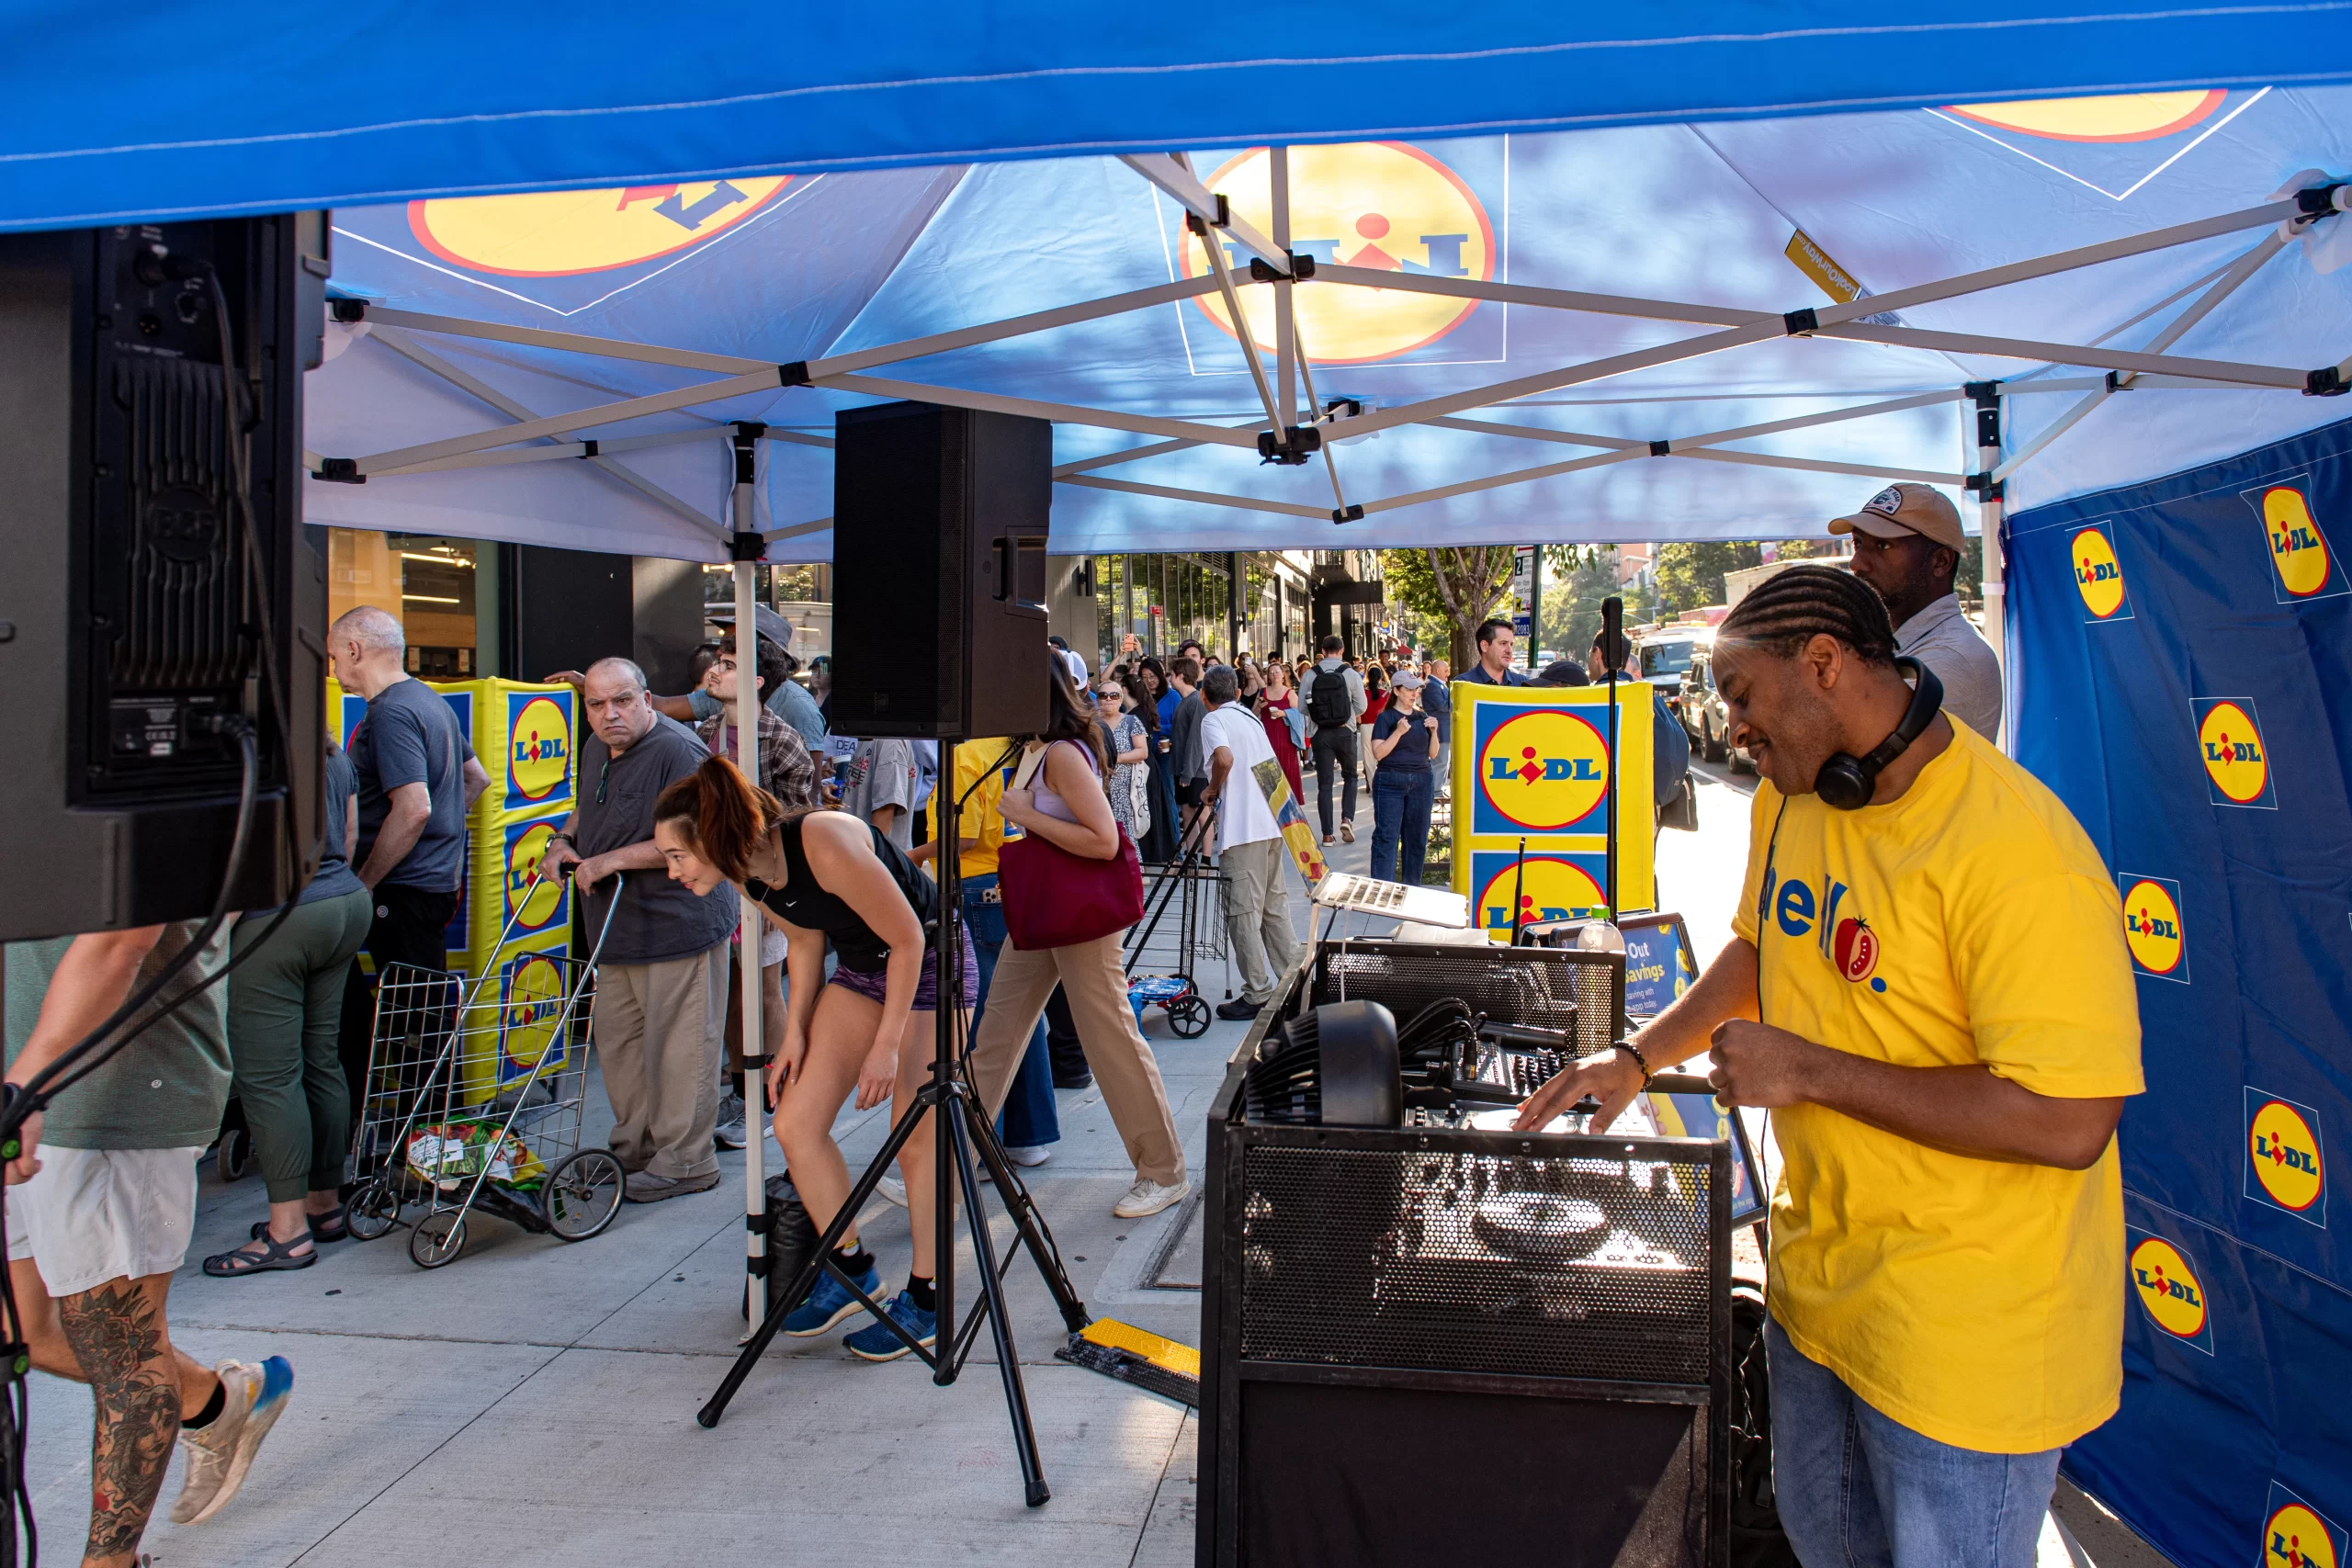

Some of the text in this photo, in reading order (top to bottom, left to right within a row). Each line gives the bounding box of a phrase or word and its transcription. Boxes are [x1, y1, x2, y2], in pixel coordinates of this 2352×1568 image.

[1794, 231, 1857, 299] LookOurWay.com
[1516, 558, 1521, 575] 2
[1627, 942, 1650, 959] Out
